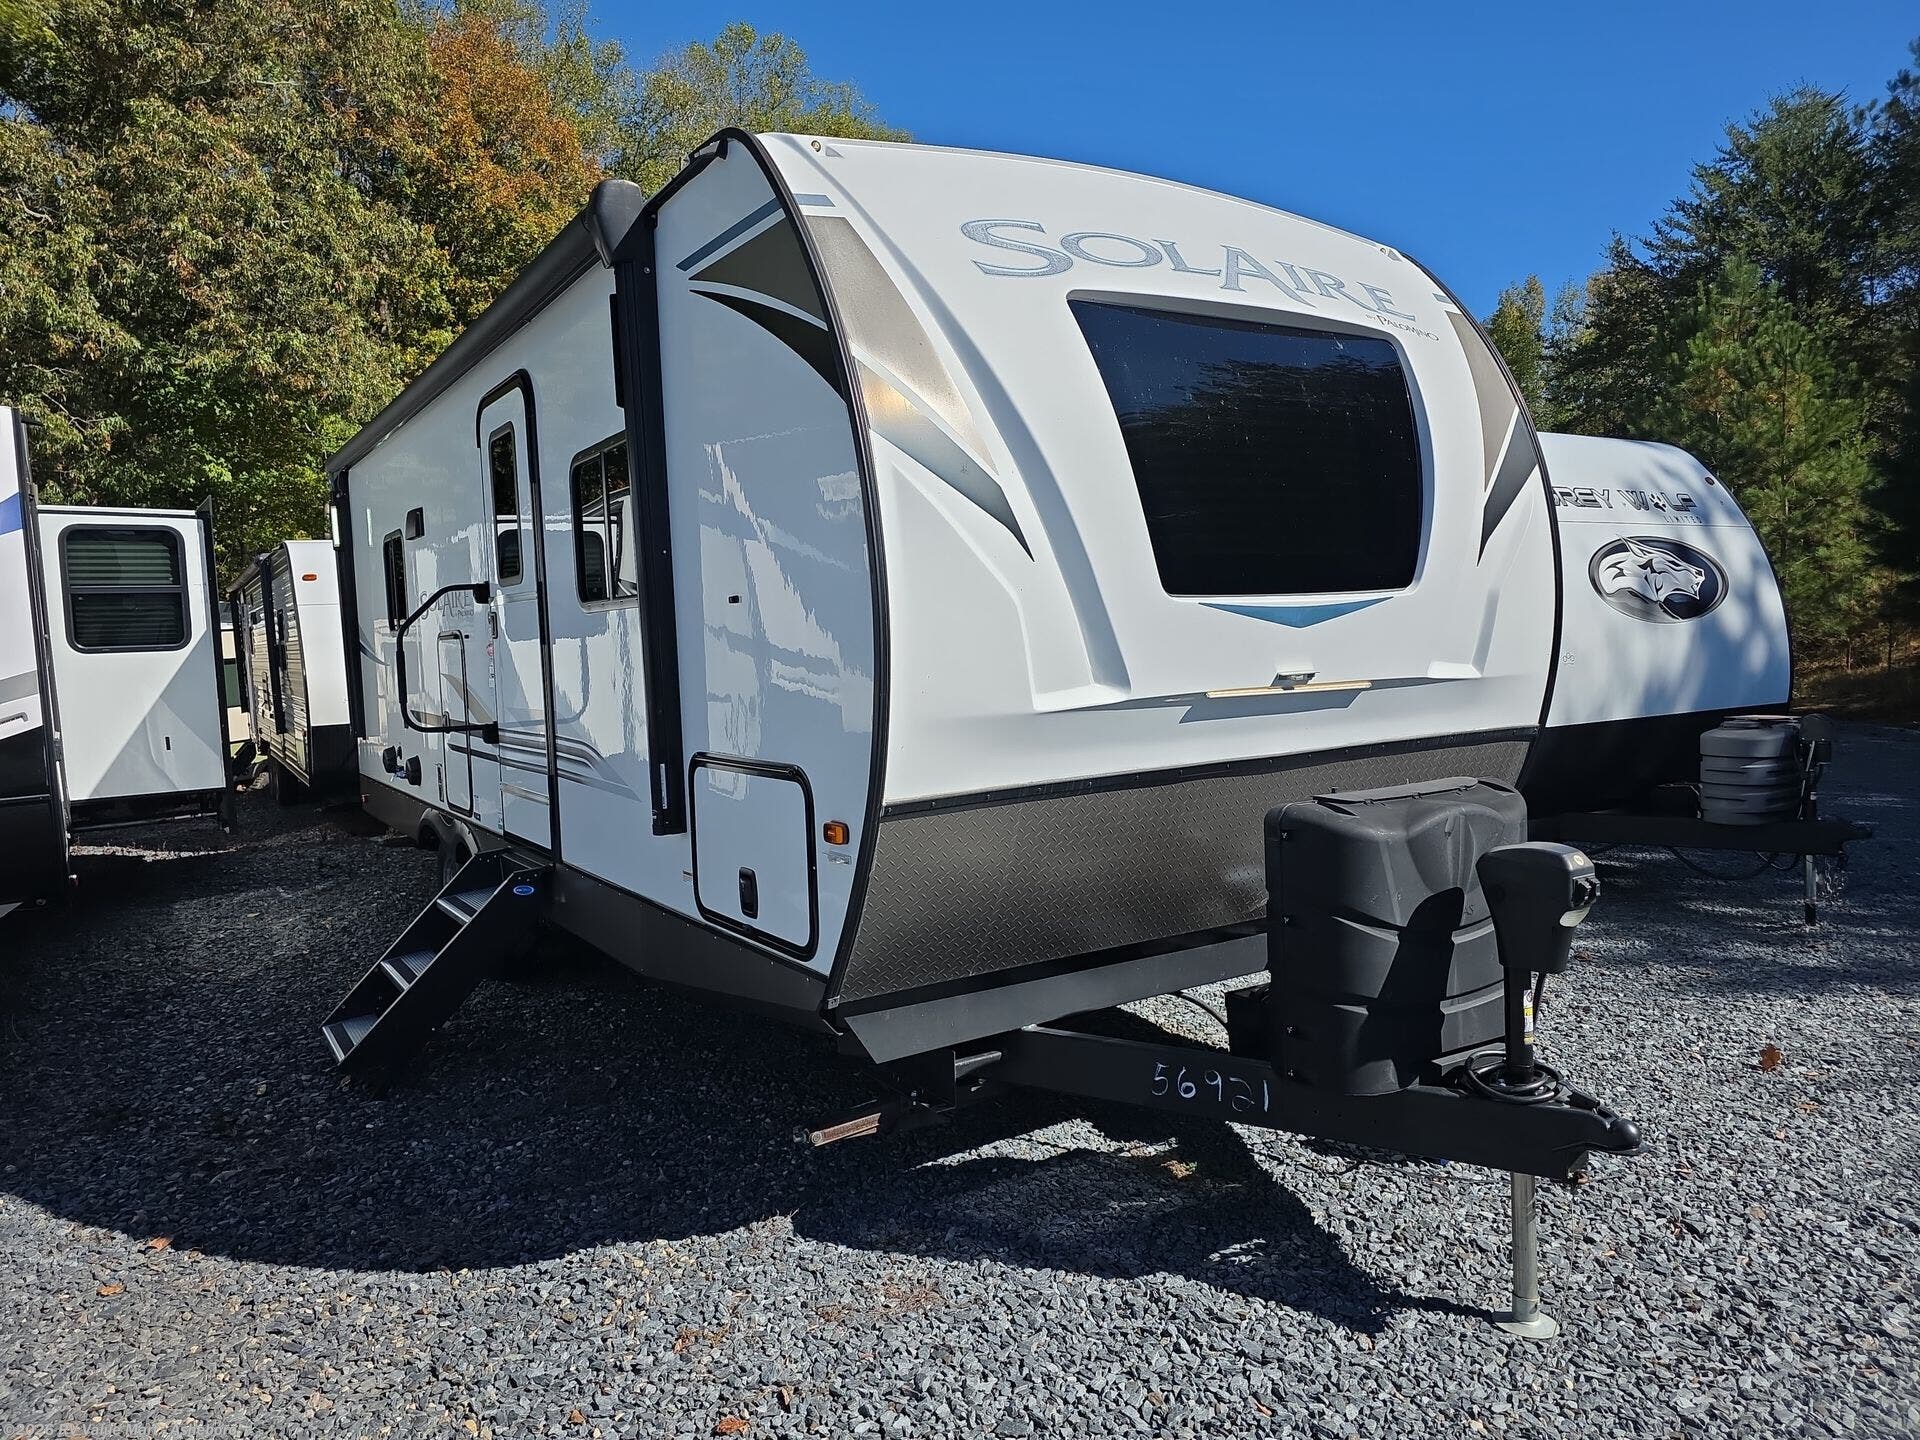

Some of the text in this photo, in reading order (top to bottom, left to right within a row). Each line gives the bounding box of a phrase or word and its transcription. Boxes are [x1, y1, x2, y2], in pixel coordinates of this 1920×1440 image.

[960, 218, 1416, 320] SOLAIRE
[1552, 486, 1613, 508] REY
[1151, 1061, 1269, 1112] 56921
